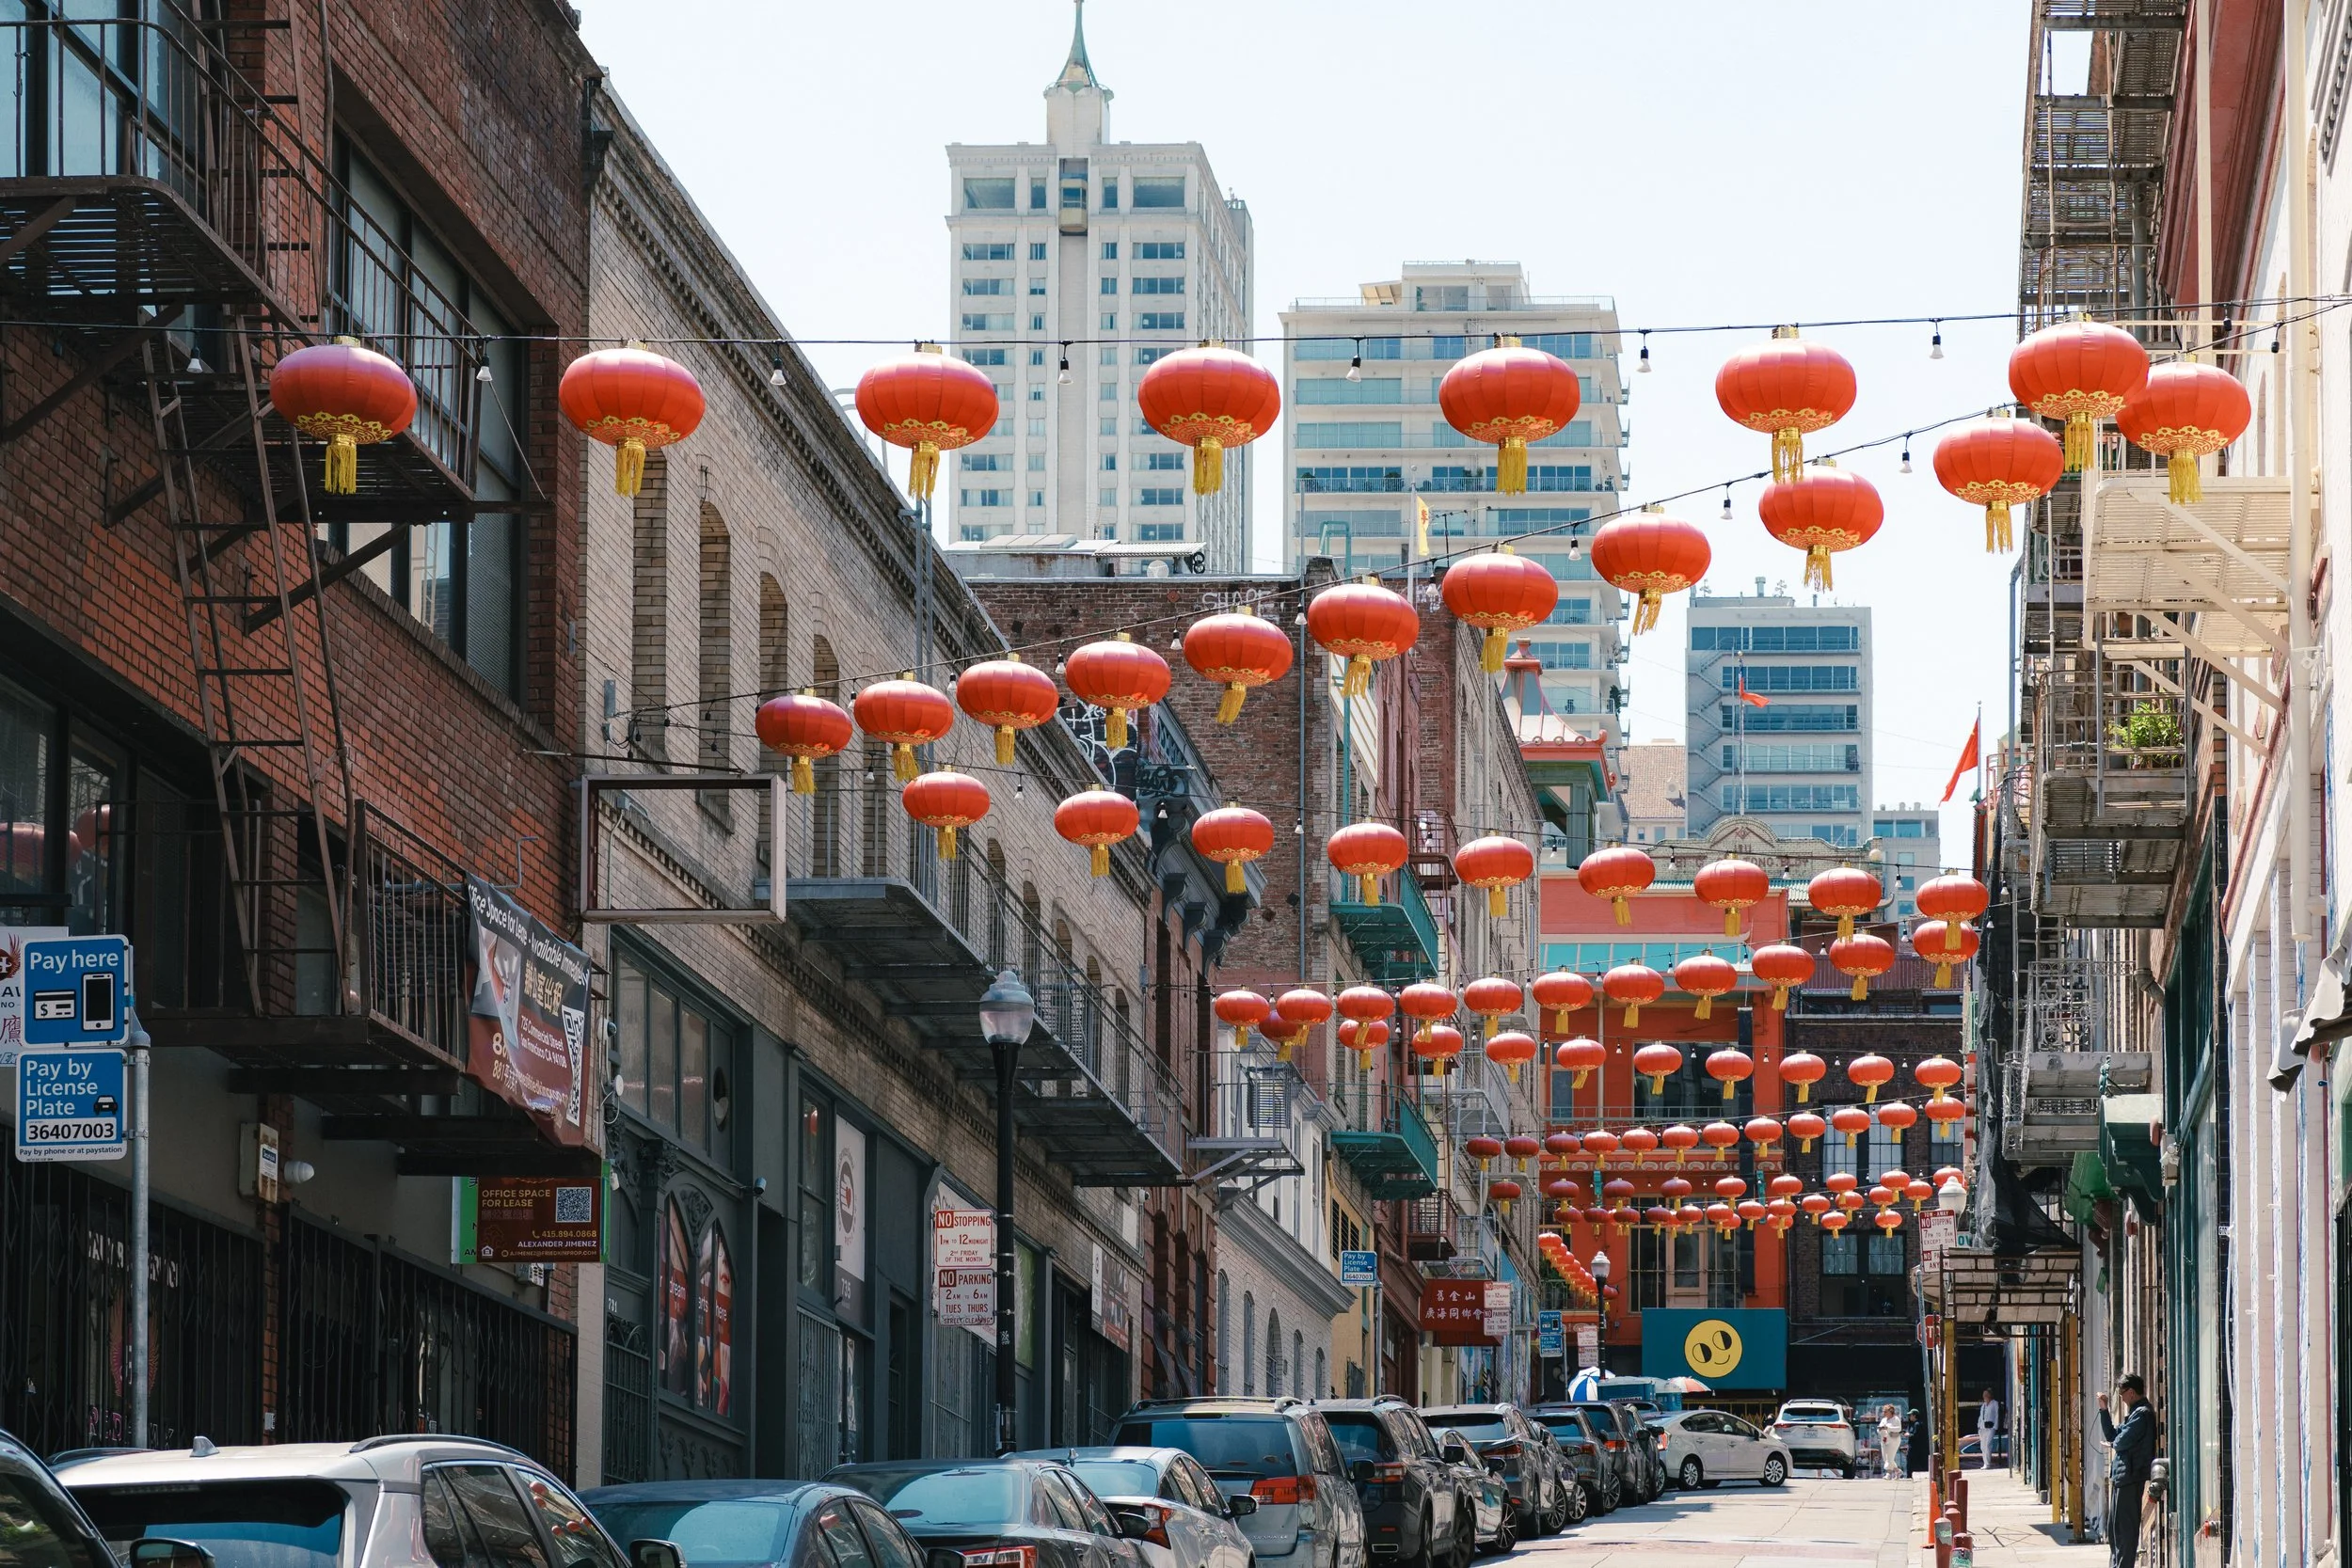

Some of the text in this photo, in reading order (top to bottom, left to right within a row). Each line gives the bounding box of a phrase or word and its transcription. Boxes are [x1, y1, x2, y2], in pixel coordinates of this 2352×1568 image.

[30, 949, 119, 974] Pay here
[25, 1058, 92, 1081] Pay by
[26, 1079, 98, 1097] License
[25, 1099, 75, 1117] Plate
[28, 1123, 115, 1140] 36407003
[19, 1148, 33, 1157] Pay
[34, 1147, 42, 1156] by
[44, 1147, 67, 1156] phone
[86, 1146, 122, 1155] paystation
[482, 1189, 551, 1198] OFFICE SPACE
[482, 1199, 501, 1208] FOR
[938, 1212, 991, 1227] NO STOPPING
[1921, 1217, 1952, 1227] NO STOPPING
[1923, 1252, 1931, 1260] NO
[941, 1272, 992, 1286] NO PARKING
[841, 1278, 851, 1300] 735
[1437, 1290, 1475, 1302] 舊金山
[716, 1299, 727, 1322] here
[946, 1304, 988, 1314] TUES THURS
